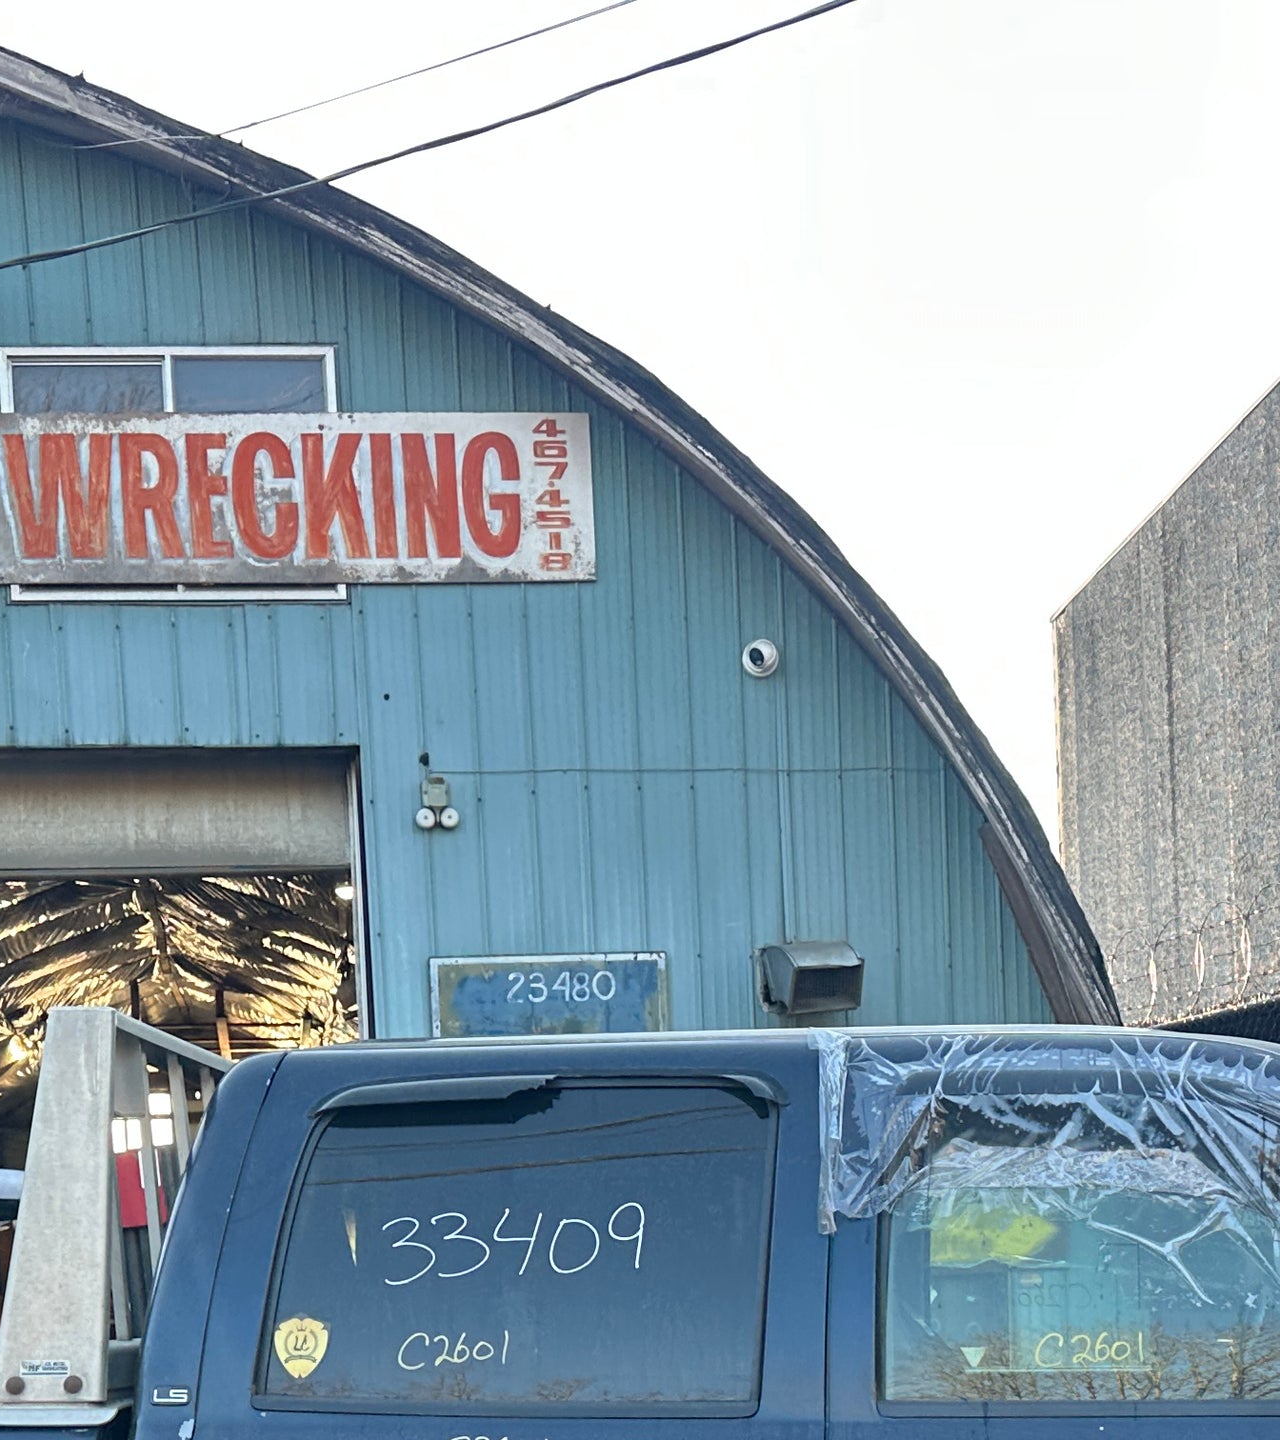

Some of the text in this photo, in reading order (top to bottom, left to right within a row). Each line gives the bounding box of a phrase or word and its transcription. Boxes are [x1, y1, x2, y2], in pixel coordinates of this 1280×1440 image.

[3, 431, 521, 560] WRECKING
[506, 970, 616, 1003] 23480
[382, 1202, 646, 1286] 33409
[397, 1331, 509, 1370] C2601
[1035, 1331, 1144, 1368] C2601
[153, 1389, 188, 1402] LS
